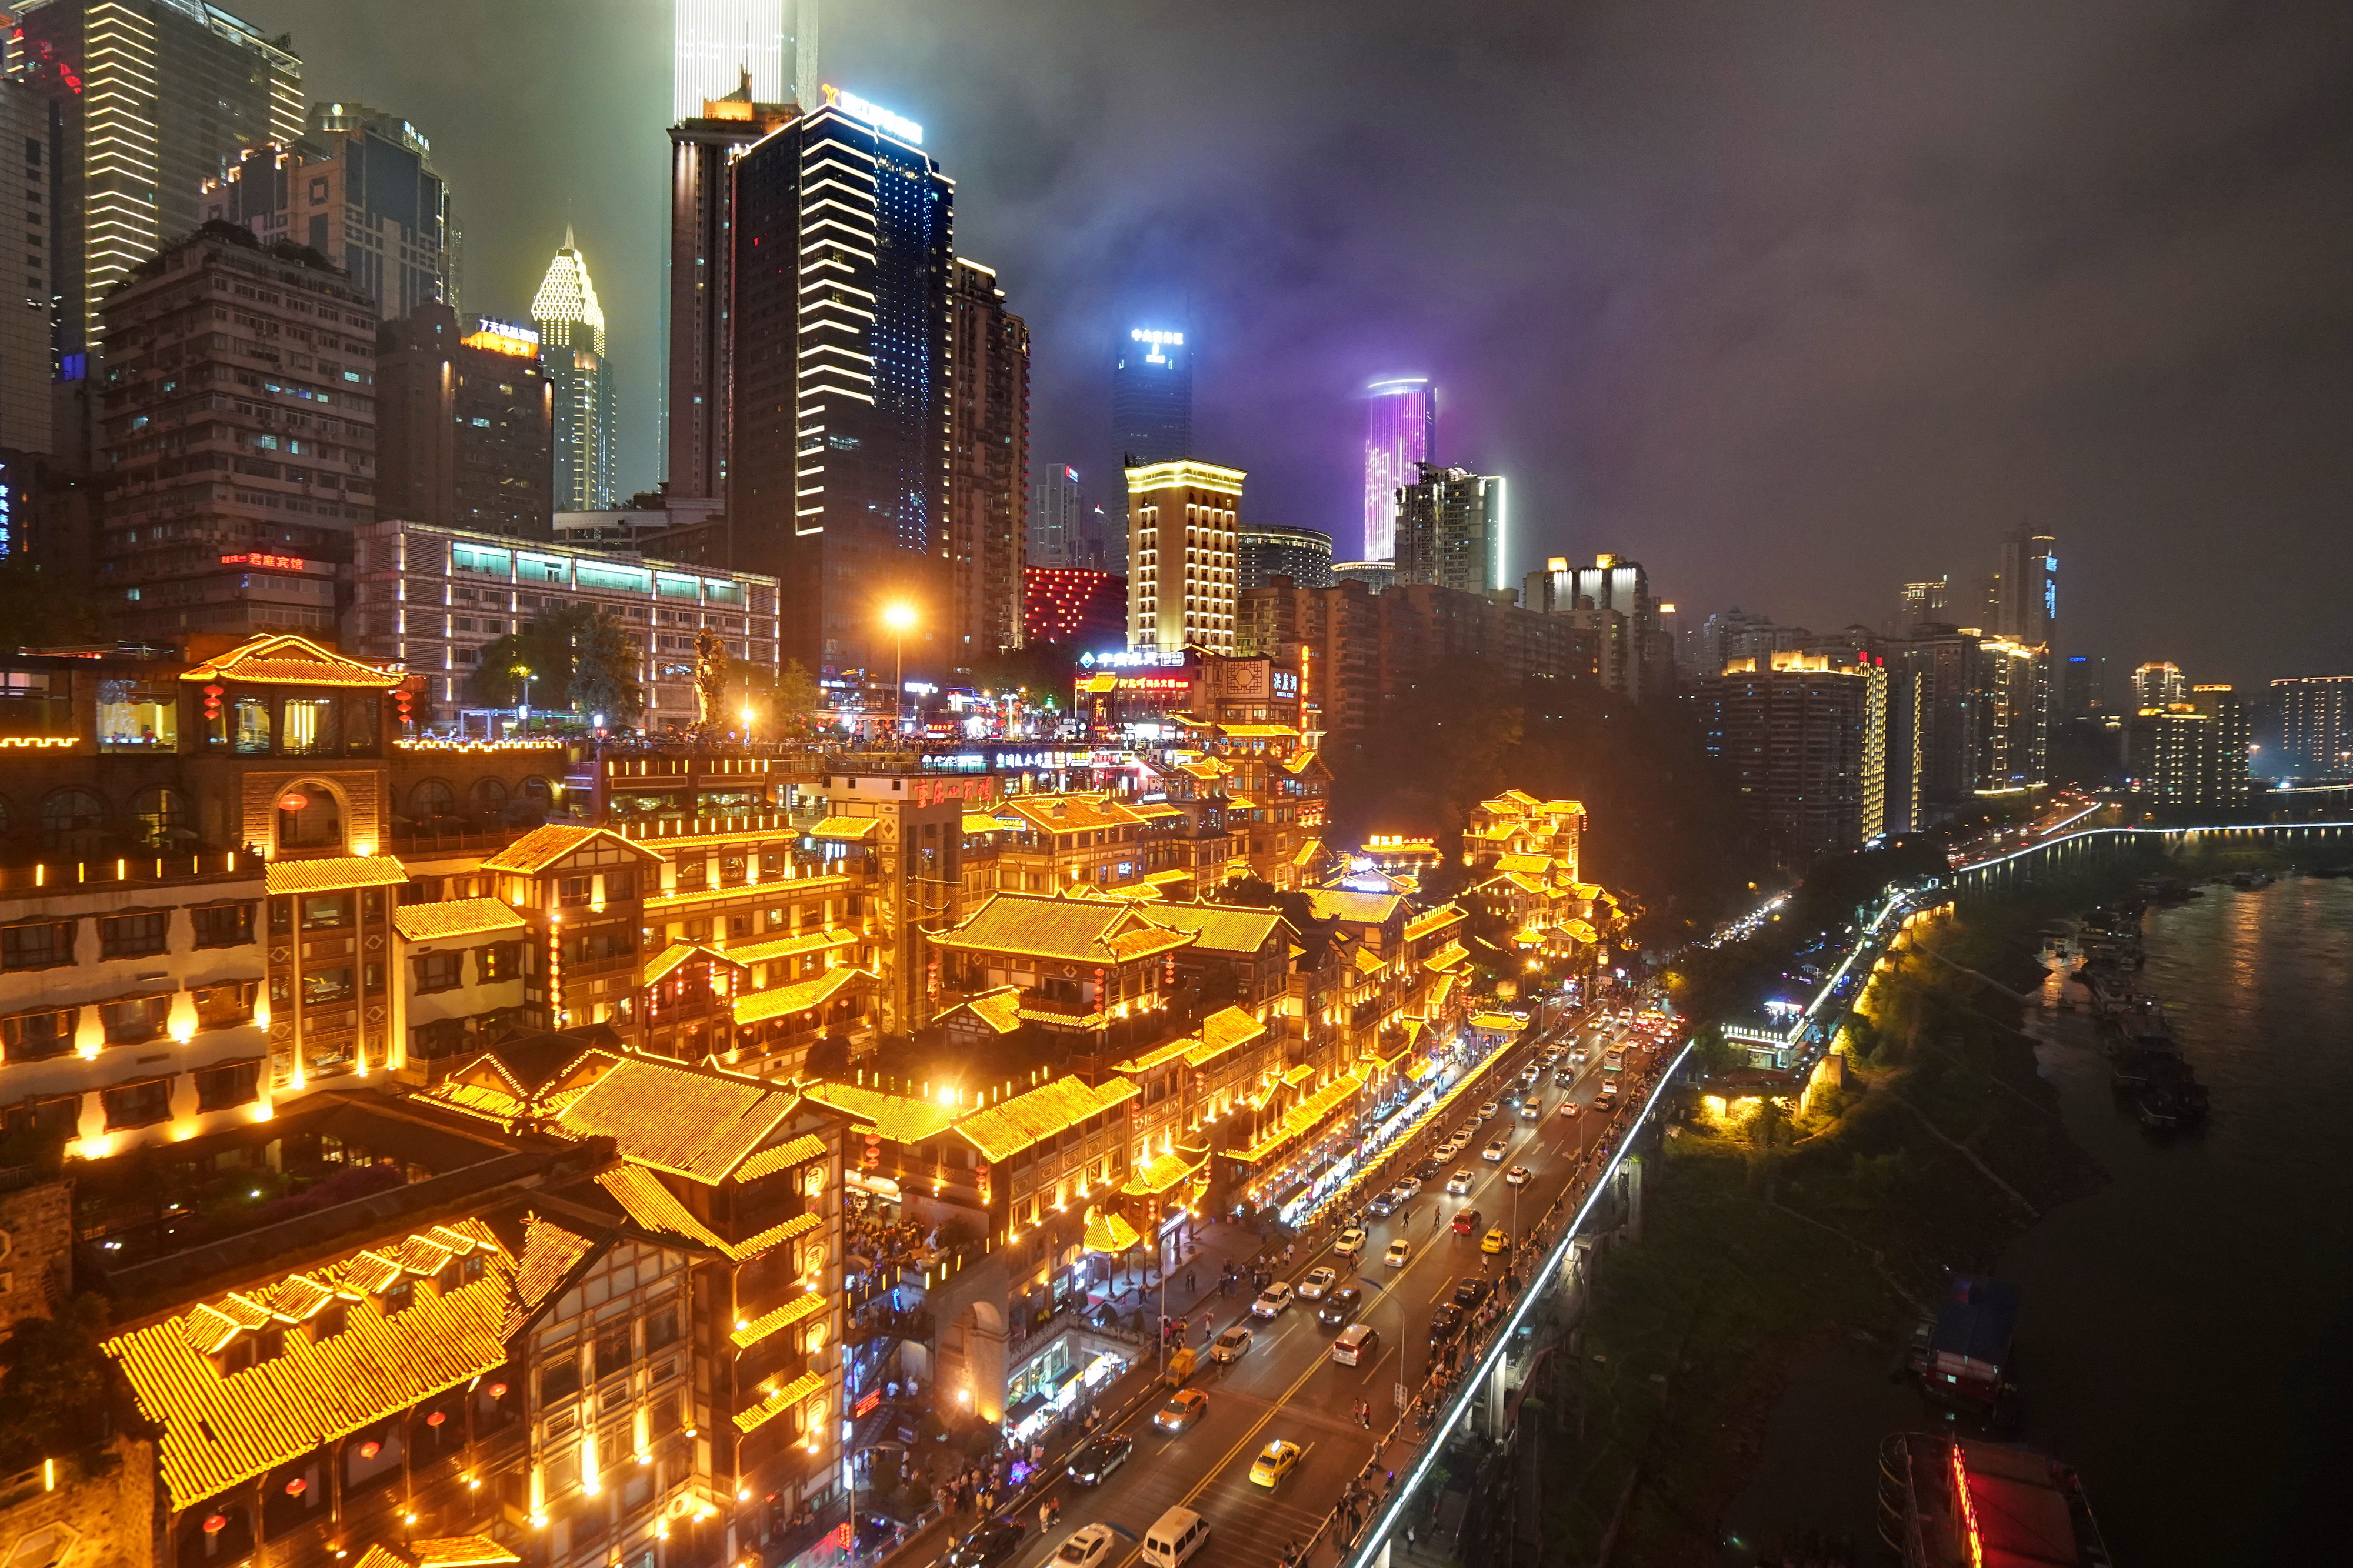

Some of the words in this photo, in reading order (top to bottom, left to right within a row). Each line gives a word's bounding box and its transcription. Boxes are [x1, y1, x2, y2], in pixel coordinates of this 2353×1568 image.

[249, 553, 304, 571] 君庭宾馆
[1274, 672, 1297, 692] 洪崖洞
